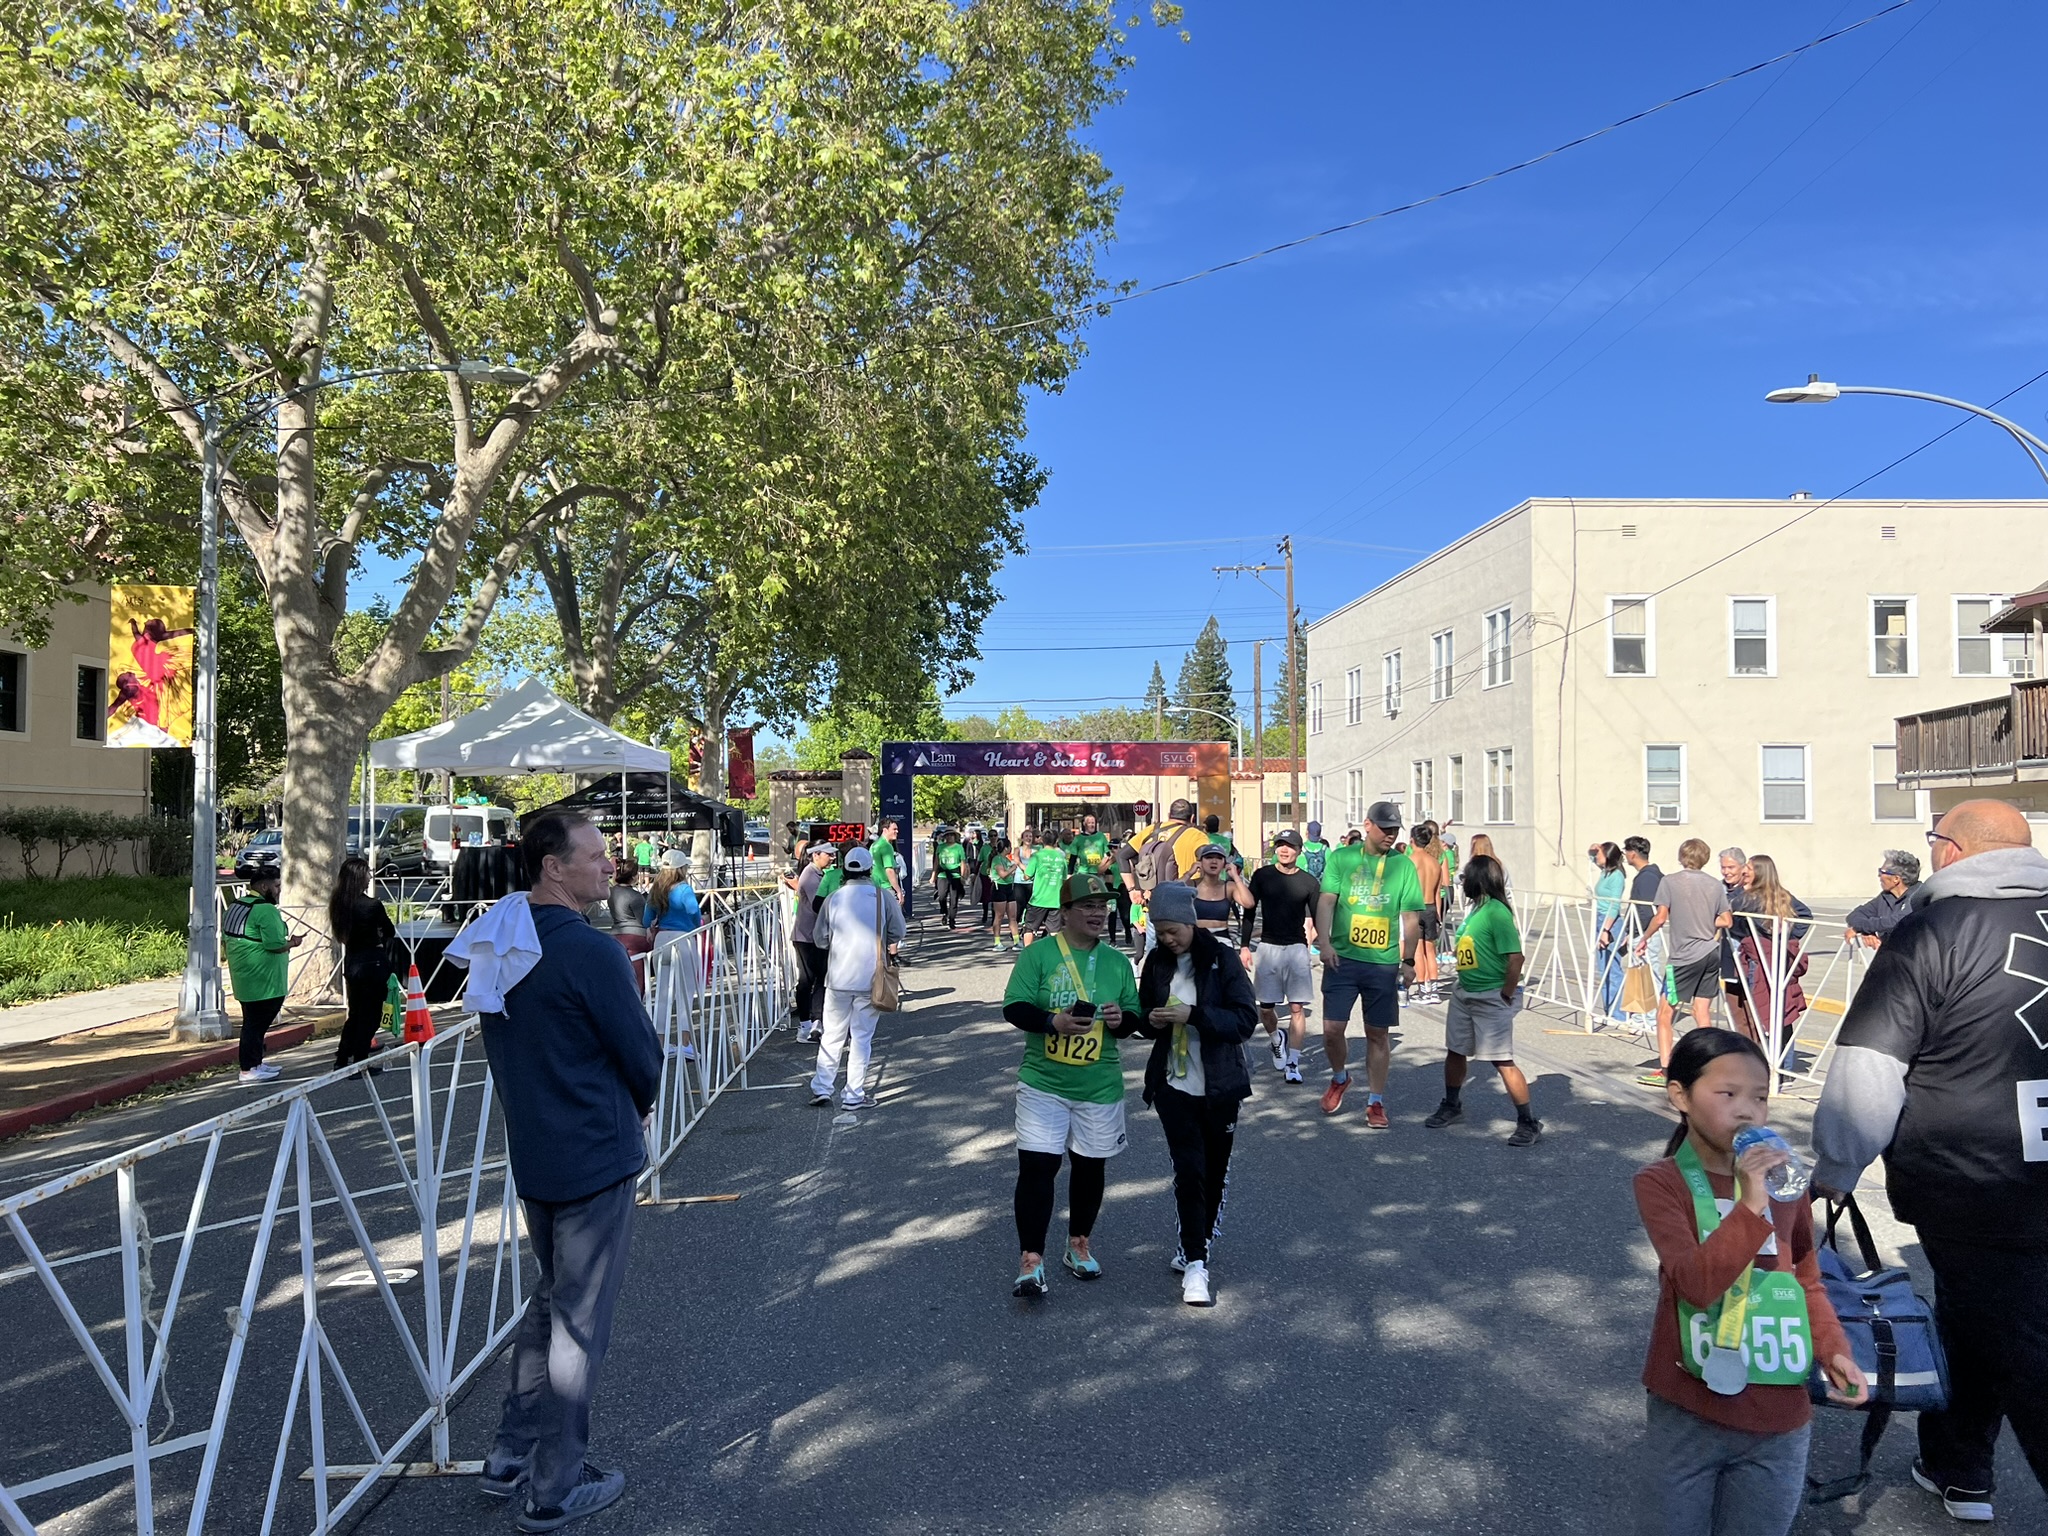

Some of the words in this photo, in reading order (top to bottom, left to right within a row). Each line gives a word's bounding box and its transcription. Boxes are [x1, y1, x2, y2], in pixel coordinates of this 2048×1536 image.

[930, 751, 956, 763] Lam
[984, 751, 1030, 767] Heart
[1033, 751, 1047, 767] &
[1051, 751, 1087, 767] Soles
[1091, 751, 1125, 767] Run
[1163, 754, 1194, 763] SVLG
[1057, 785, 1080, 793] TOGO'S
[828, 823, 863, 841] 55:53
[1352, 927, 1386, 945] 3208
[1459, 949, 1474, 966] 29
[382, 1013, 393, 1025] 69
[1047, 1033, 1098, 1061] 3122
[1690, 1312, 1807, 1373] 655
